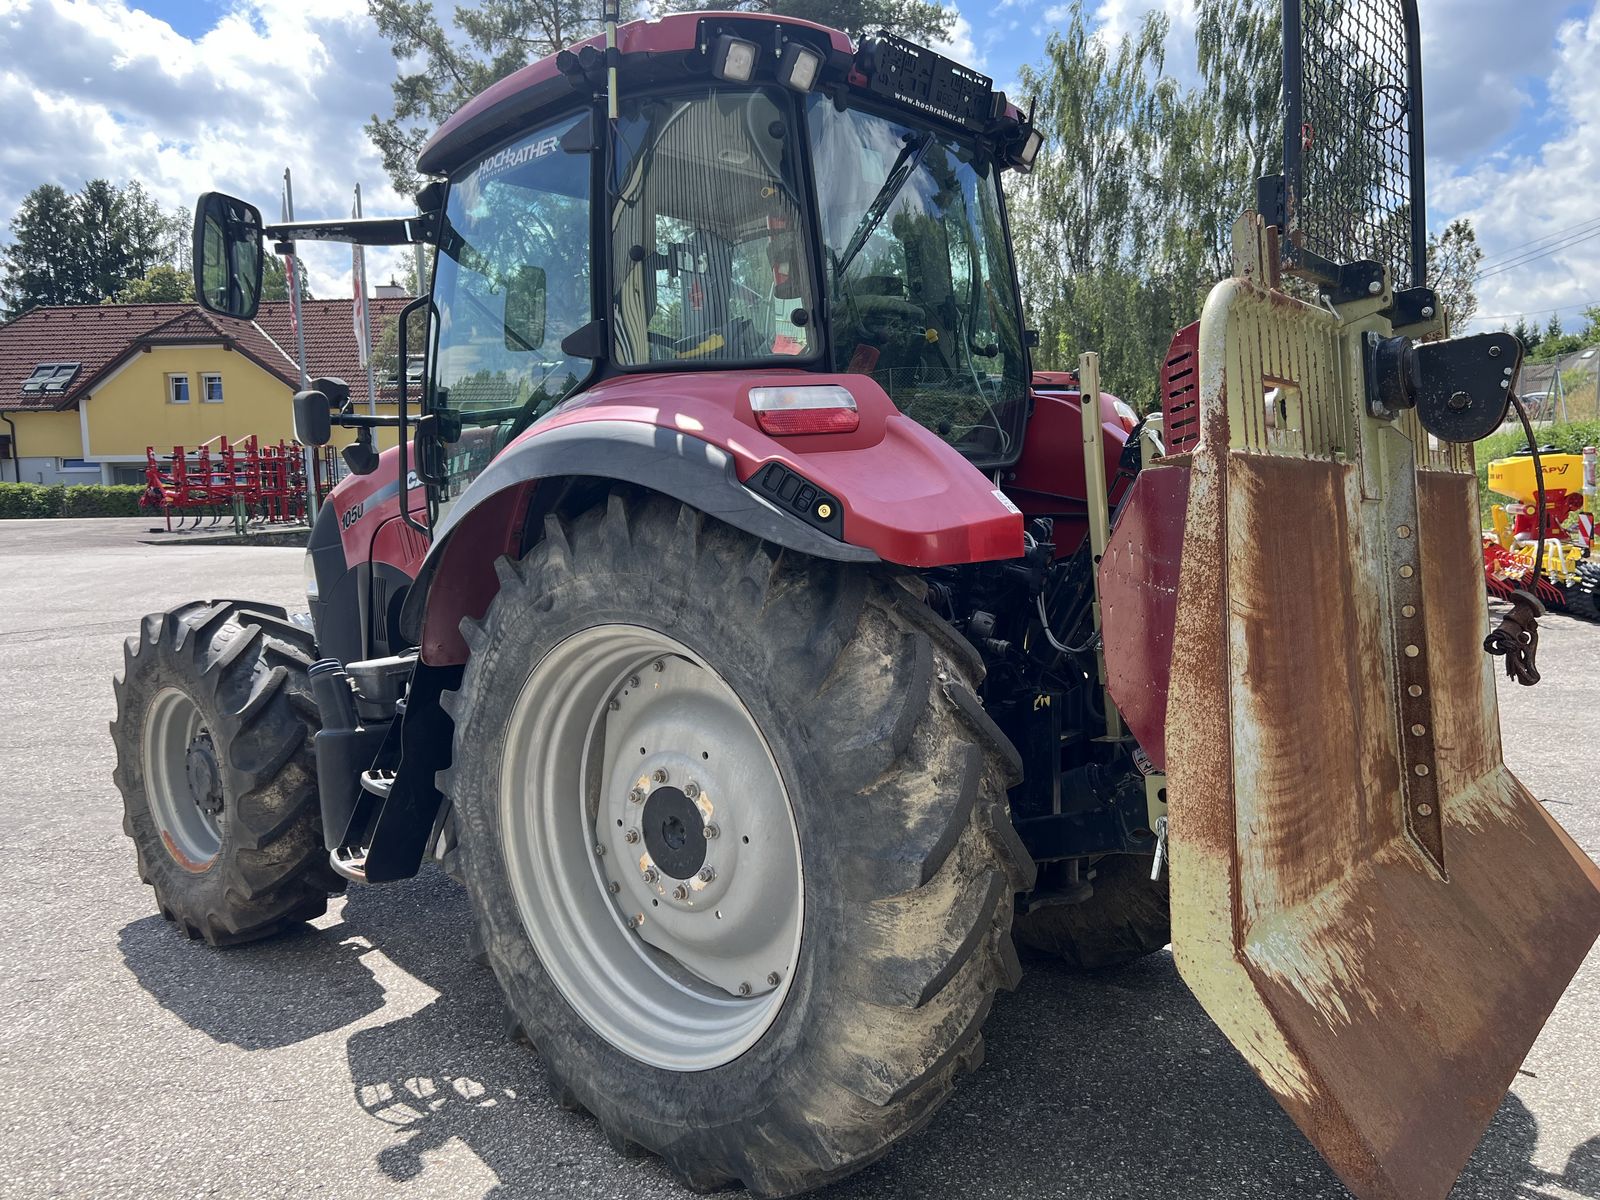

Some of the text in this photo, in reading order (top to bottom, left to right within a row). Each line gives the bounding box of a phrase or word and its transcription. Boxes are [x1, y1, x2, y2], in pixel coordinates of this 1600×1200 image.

[894, 91, 966, 125] www.hochrather.at
[478, 136, 558, 175] HOCHRATHER
[1541, 464, 1568, 474] APV
